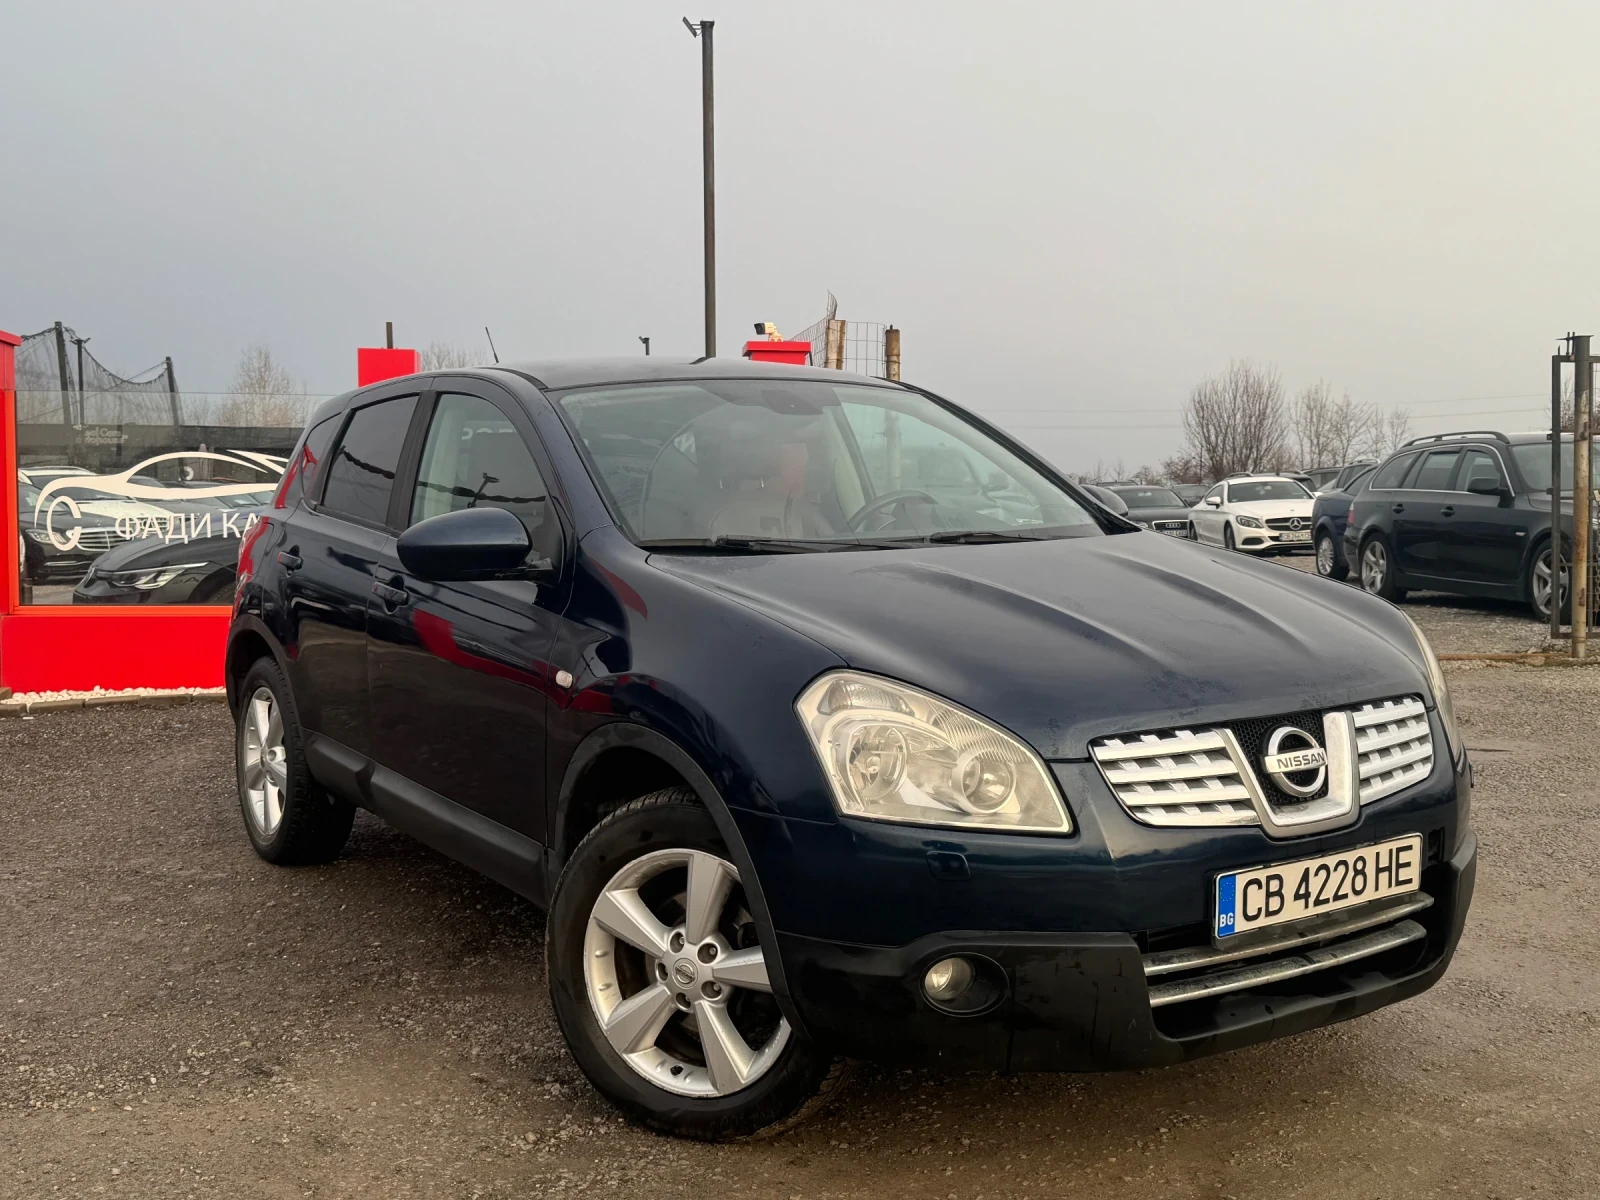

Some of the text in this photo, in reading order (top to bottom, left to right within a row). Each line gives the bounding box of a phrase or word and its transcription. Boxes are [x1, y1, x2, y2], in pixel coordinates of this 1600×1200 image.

[115, 512, 212, 545] ФАДИ
[1276, 751, 1325, 770] NISSAN
[1293, 855, 1368, 910] 4228
[1219, 912, 1234, 928] BG
